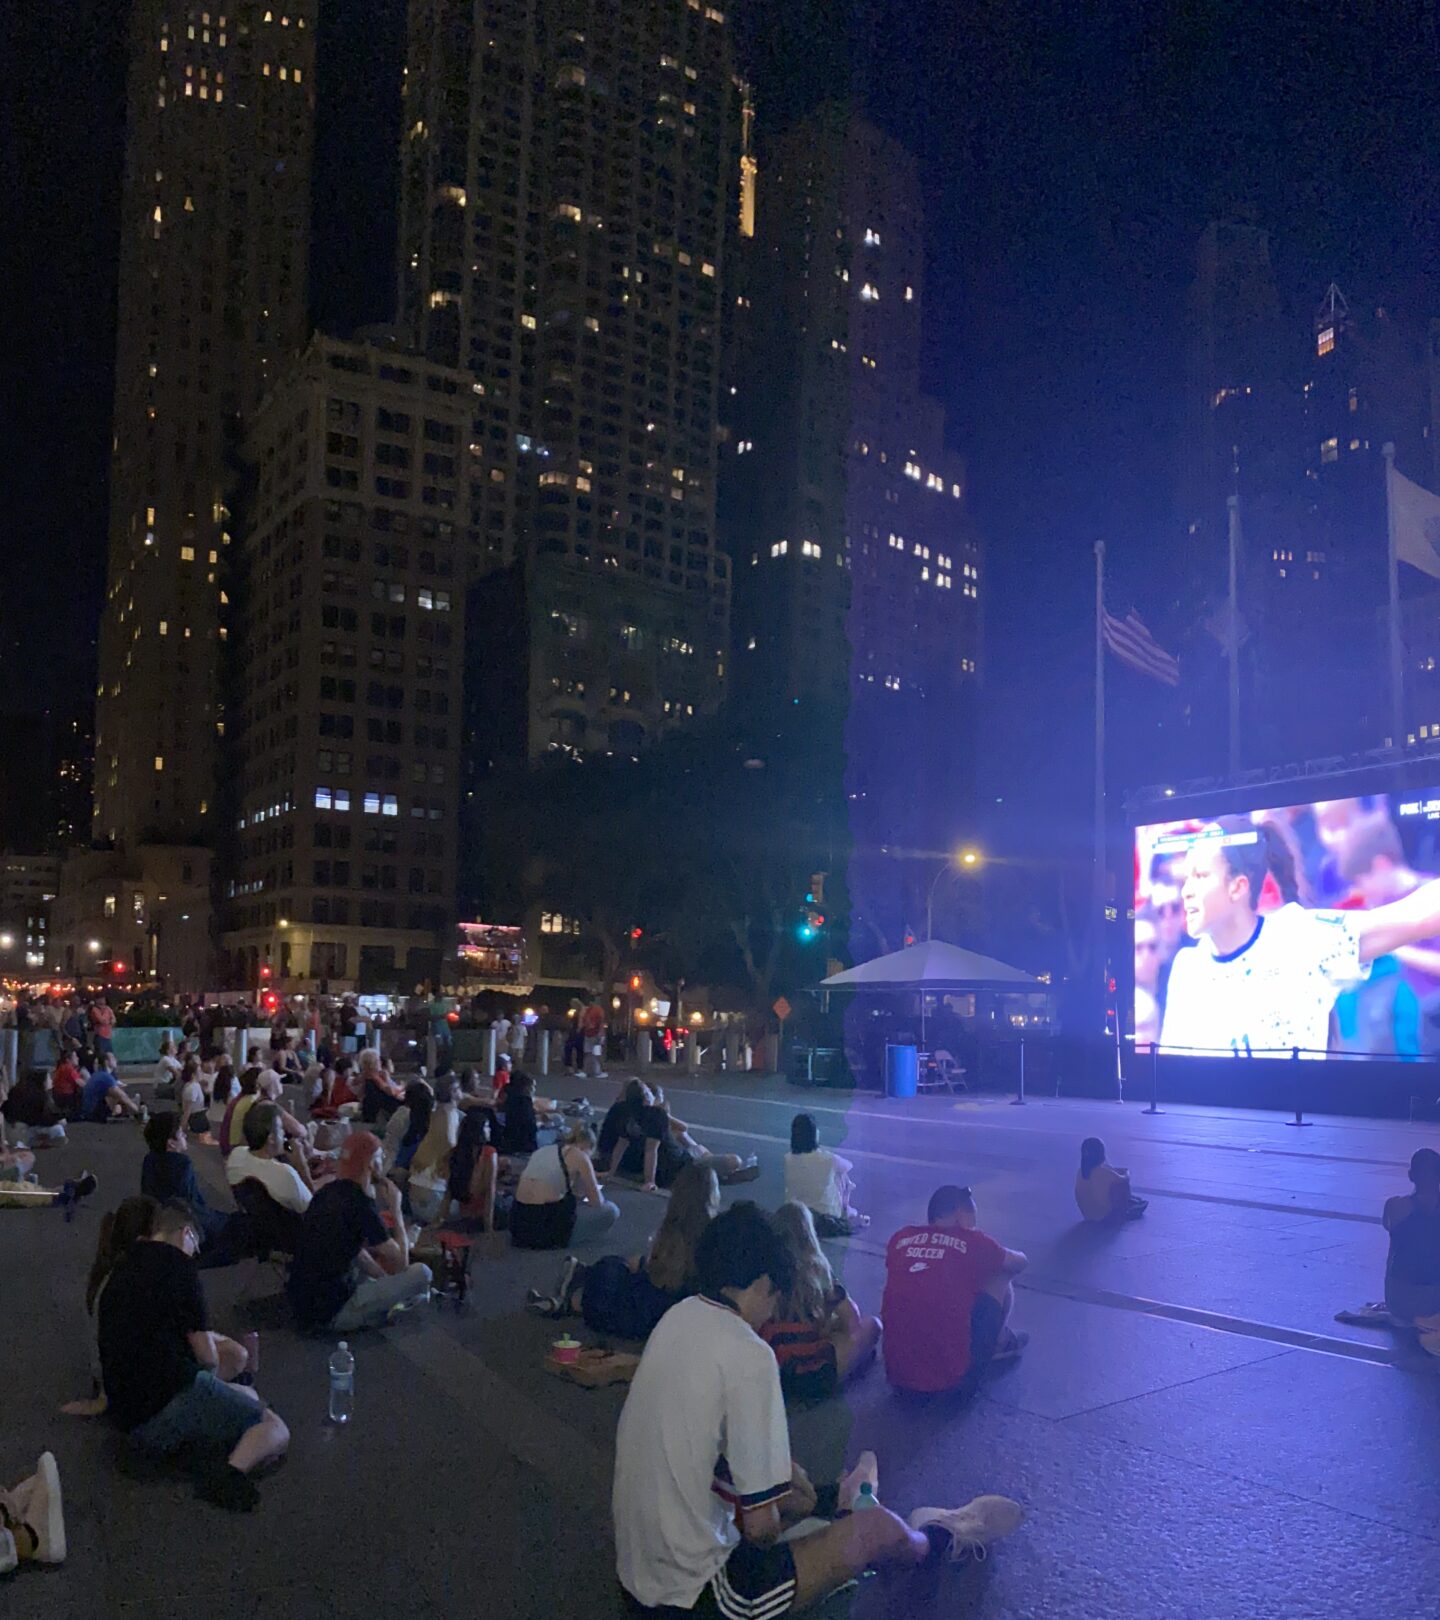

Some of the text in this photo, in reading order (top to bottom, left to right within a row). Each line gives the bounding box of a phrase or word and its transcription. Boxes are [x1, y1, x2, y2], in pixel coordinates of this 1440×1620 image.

[895, 1233, 968, 1255] UNITED STATES
[906, 1247, 946, 1259] SOCCER
